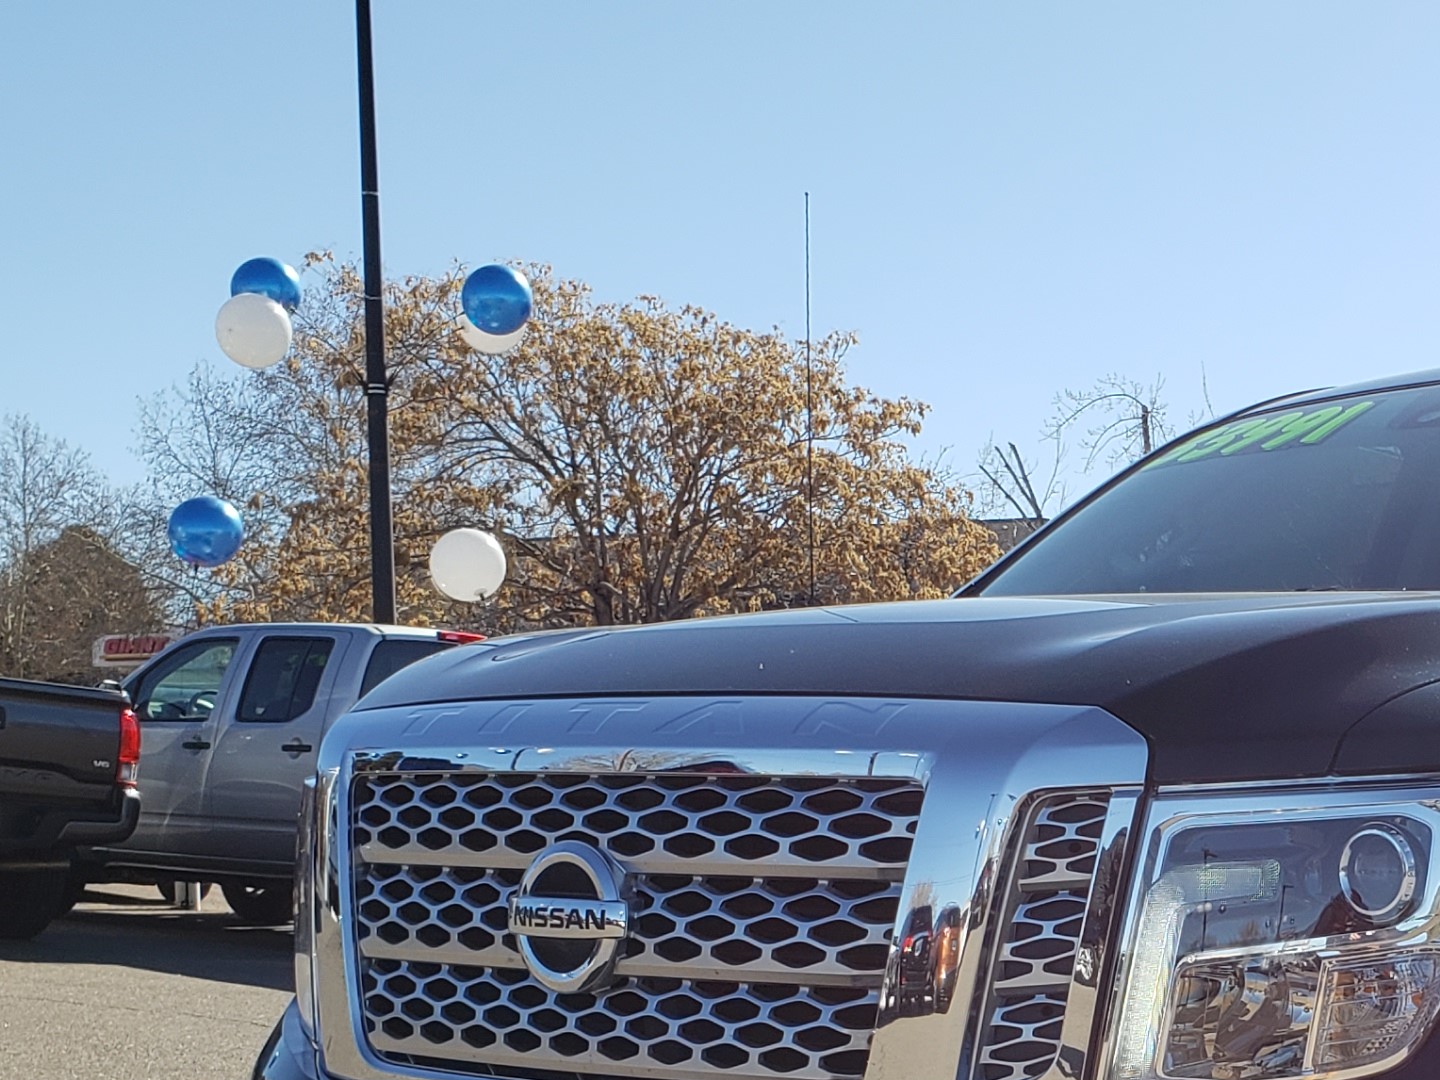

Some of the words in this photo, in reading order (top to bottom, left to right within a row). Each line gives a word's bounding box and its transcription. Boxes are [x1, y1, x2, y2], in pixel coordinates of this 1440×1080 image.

[402, 700, 908, 737] TITAN
[92, 760, 110, 768] V6
[514, 905, 606, 930] NISSAN
